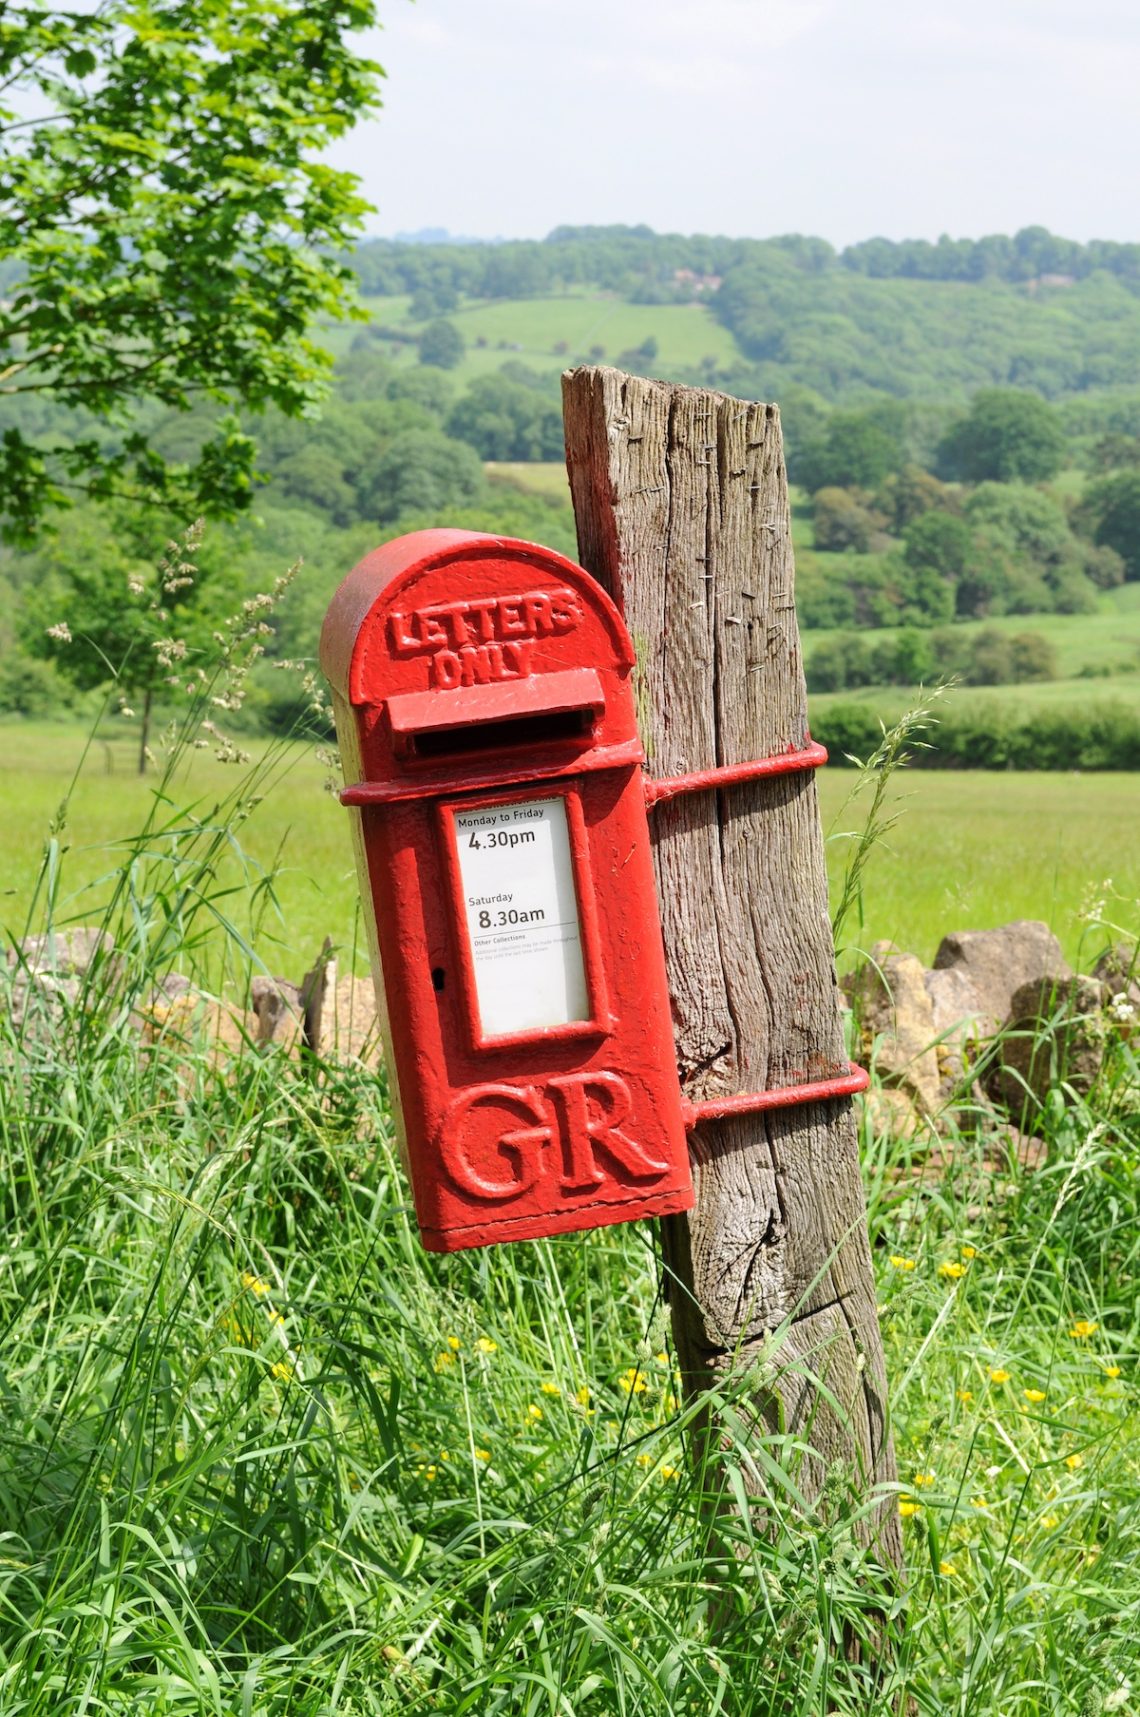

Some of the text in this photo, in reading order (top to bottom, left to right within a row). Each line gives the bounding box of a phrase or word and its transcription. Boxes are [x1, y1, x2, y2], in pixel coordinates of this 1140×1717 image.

[387, 588, 581, 653] LETTERS
[431, 640, 533, 690] ONLY
[458, 808, 545, 828] Monday to Friday
[468, 831, 535, 850] 4.30pm
[468, 893, 513, 907] Saturday
[478, 909, 545, 929] 8.30am
[474, 939, 491, 947] Other
[493, 934, 526, 944] Collections
[441, 1070, 671, 1202] GR
